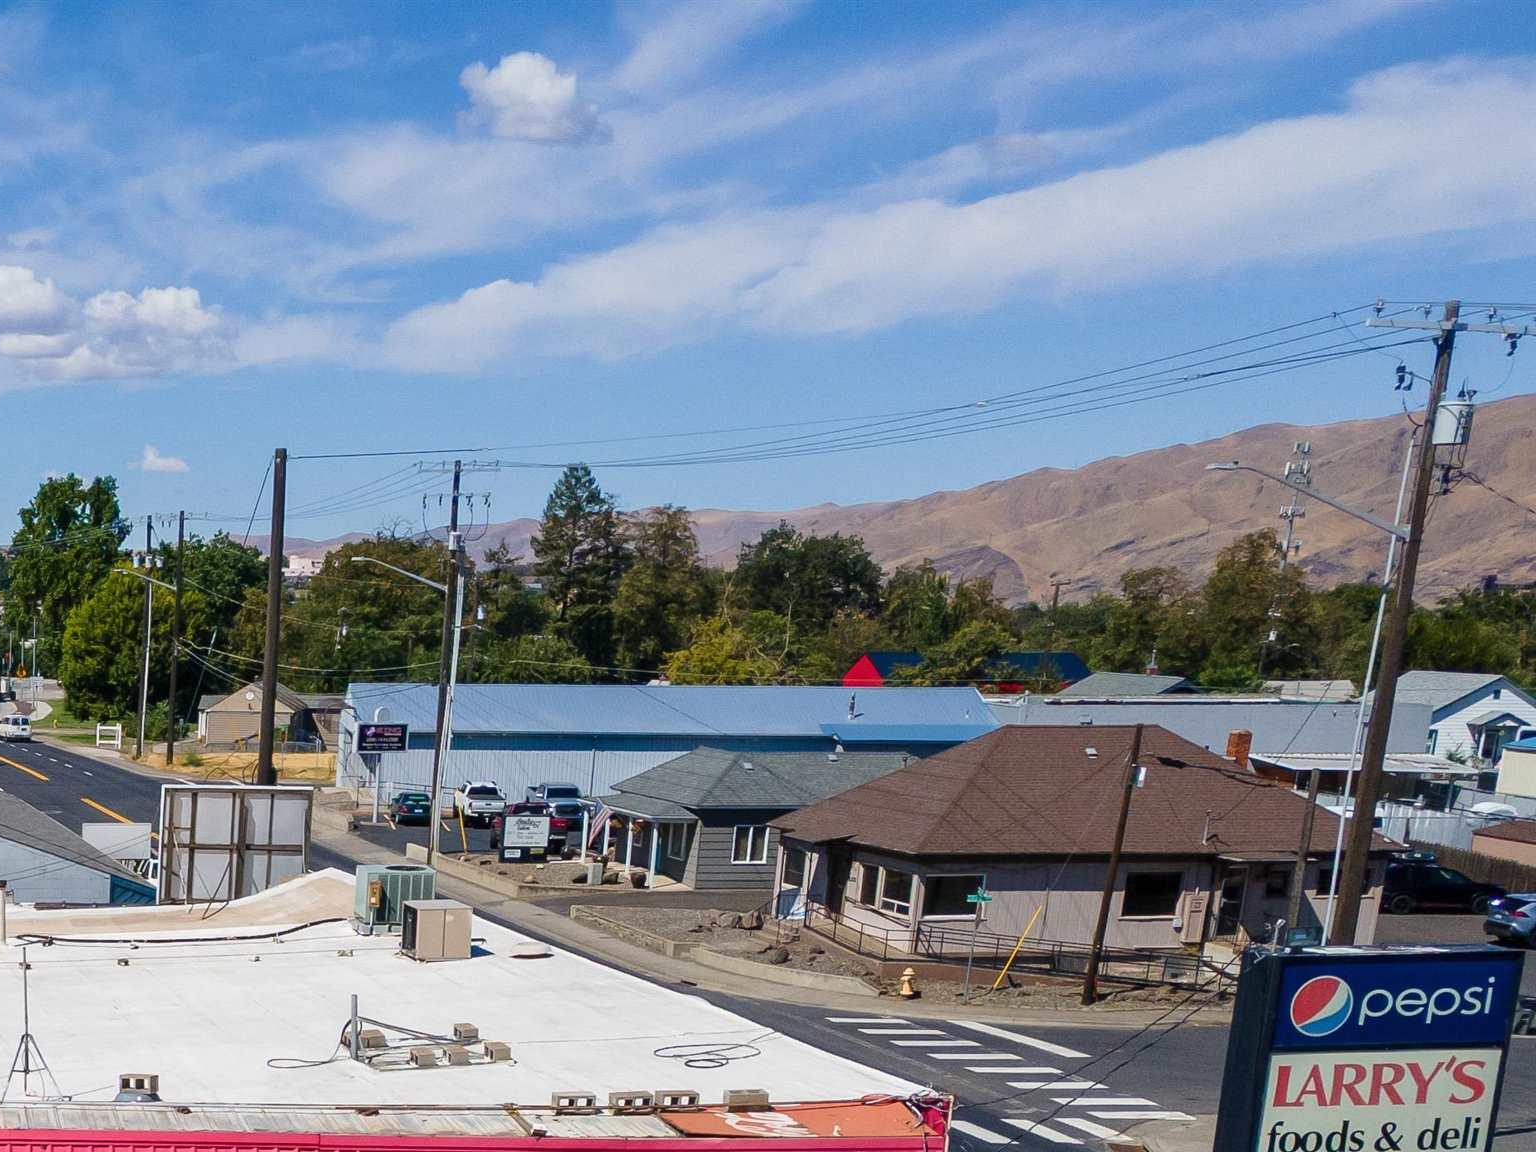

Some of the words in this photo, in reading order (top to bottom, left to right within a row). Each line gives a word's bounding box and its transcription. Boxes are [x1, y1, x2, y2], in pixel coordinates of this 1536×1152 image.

[1358, 976, 1496, 1026] pepsi
[1272, 1055, 1486, 1108] LARRY'S
[1267, 1120, 1365, 1152] foods
[1373, 1121, 1404, 1152] &
[1417, 1116, 1481, 1151] deli
